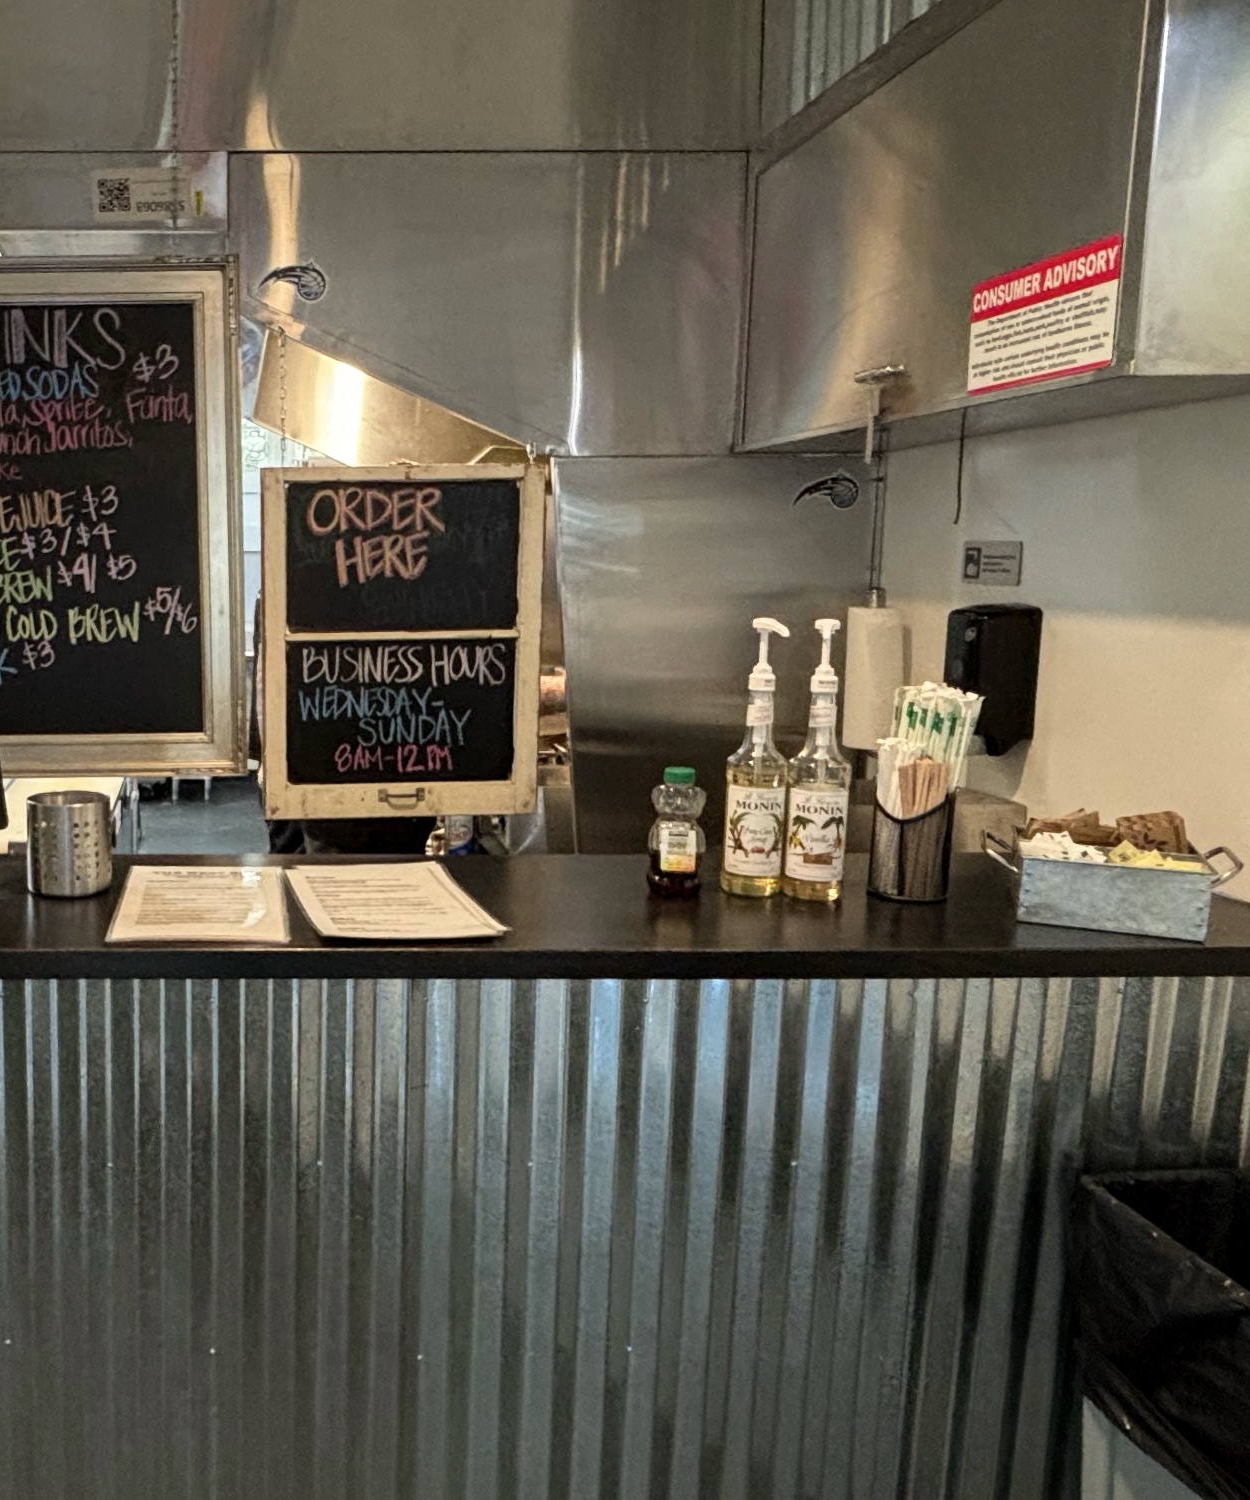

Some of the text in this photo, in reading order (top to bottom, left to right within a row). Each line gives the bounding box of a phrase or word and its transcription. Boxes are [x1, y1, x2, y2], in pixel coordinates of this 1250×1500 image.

[973, 272, 1041, 313] CONSUMER
[1043, 246, 1120, 291] ADVISORY
[21, 361, 99, 401] SODAS
[132, 344, 180, 383] $3
[14, 489, 77, 533] JUICE
[82, 485, 119, 521] $3
[307, 487, 446, 535] ORDER
[335, 530, 431, 588] HERE
[5, 604, 58, 643] COLD
[68, 600, 141, 645] BREW
[21, 640, 55, 670] $3
[302, 643, 506, 686] BUSINESS HOURS
[357, 708, 472, 747] SUNDAY
[736, 800, 782, 811] MONIN
[795, 803, 844, 815] MONIN
